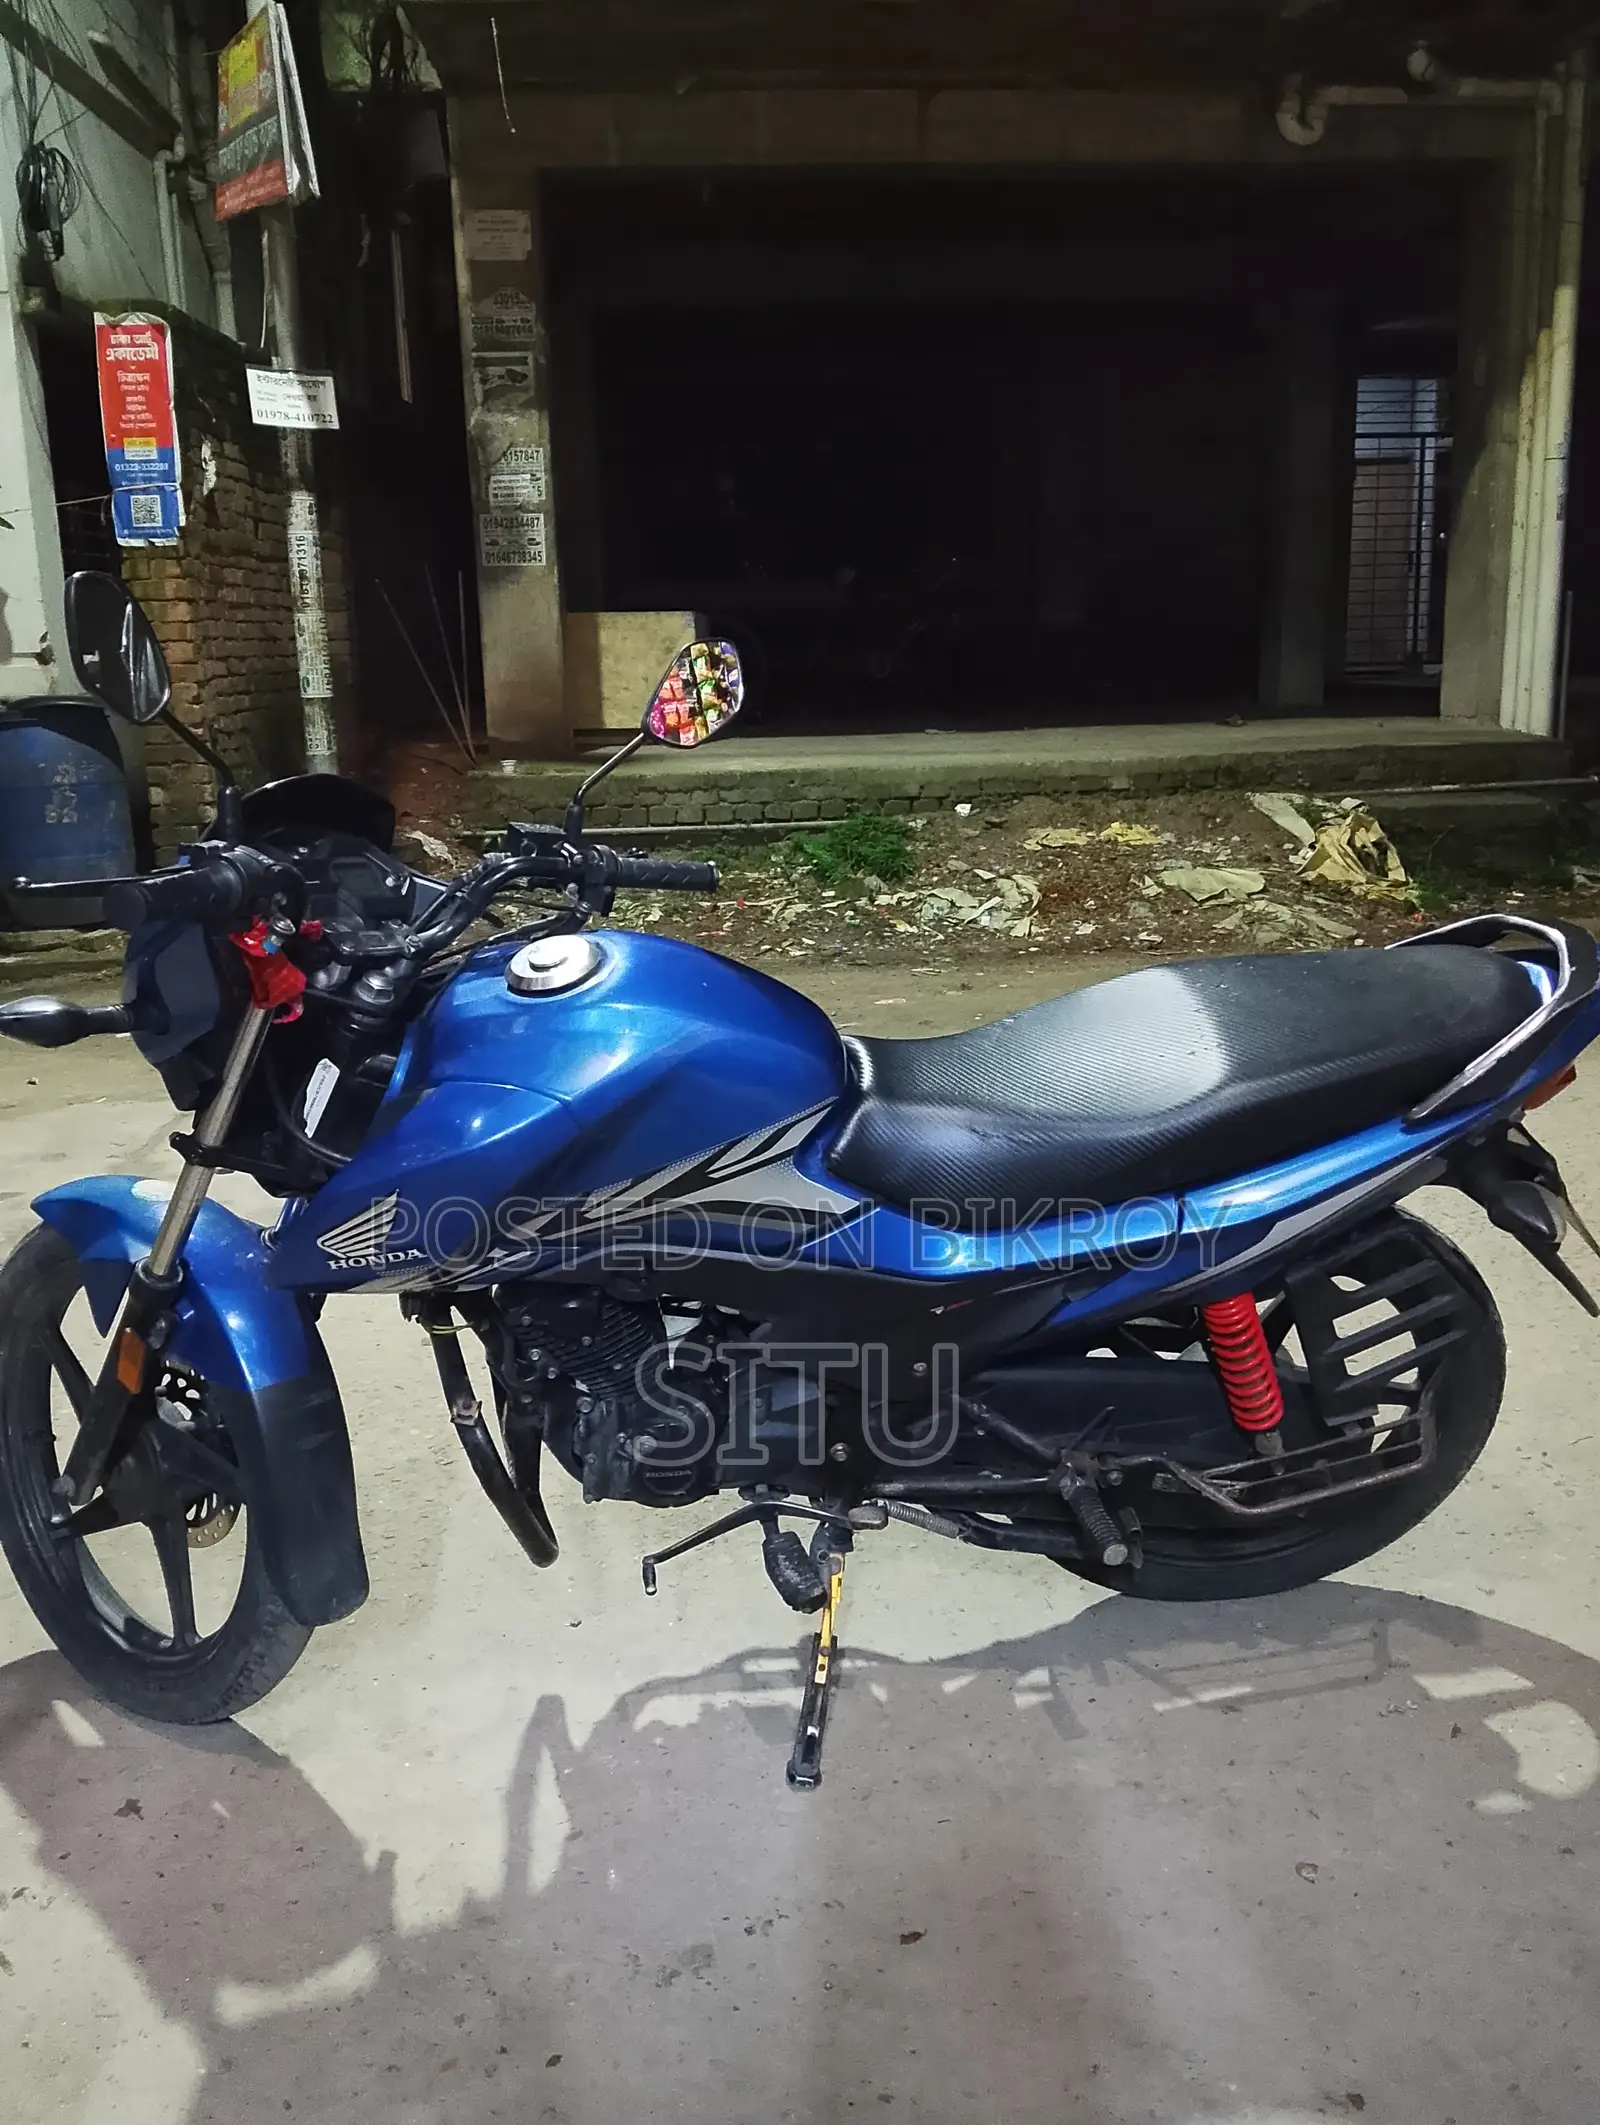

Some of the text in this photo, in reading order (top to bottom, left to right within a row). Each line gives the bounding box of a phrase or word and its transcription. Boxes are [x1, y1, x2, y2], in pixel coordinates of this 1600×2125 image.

[256, 408, 335, 424] 01978-410722
[327, 1248, 428, 1271] HONDA
[645, 1469, 693, 1478] HONDA
